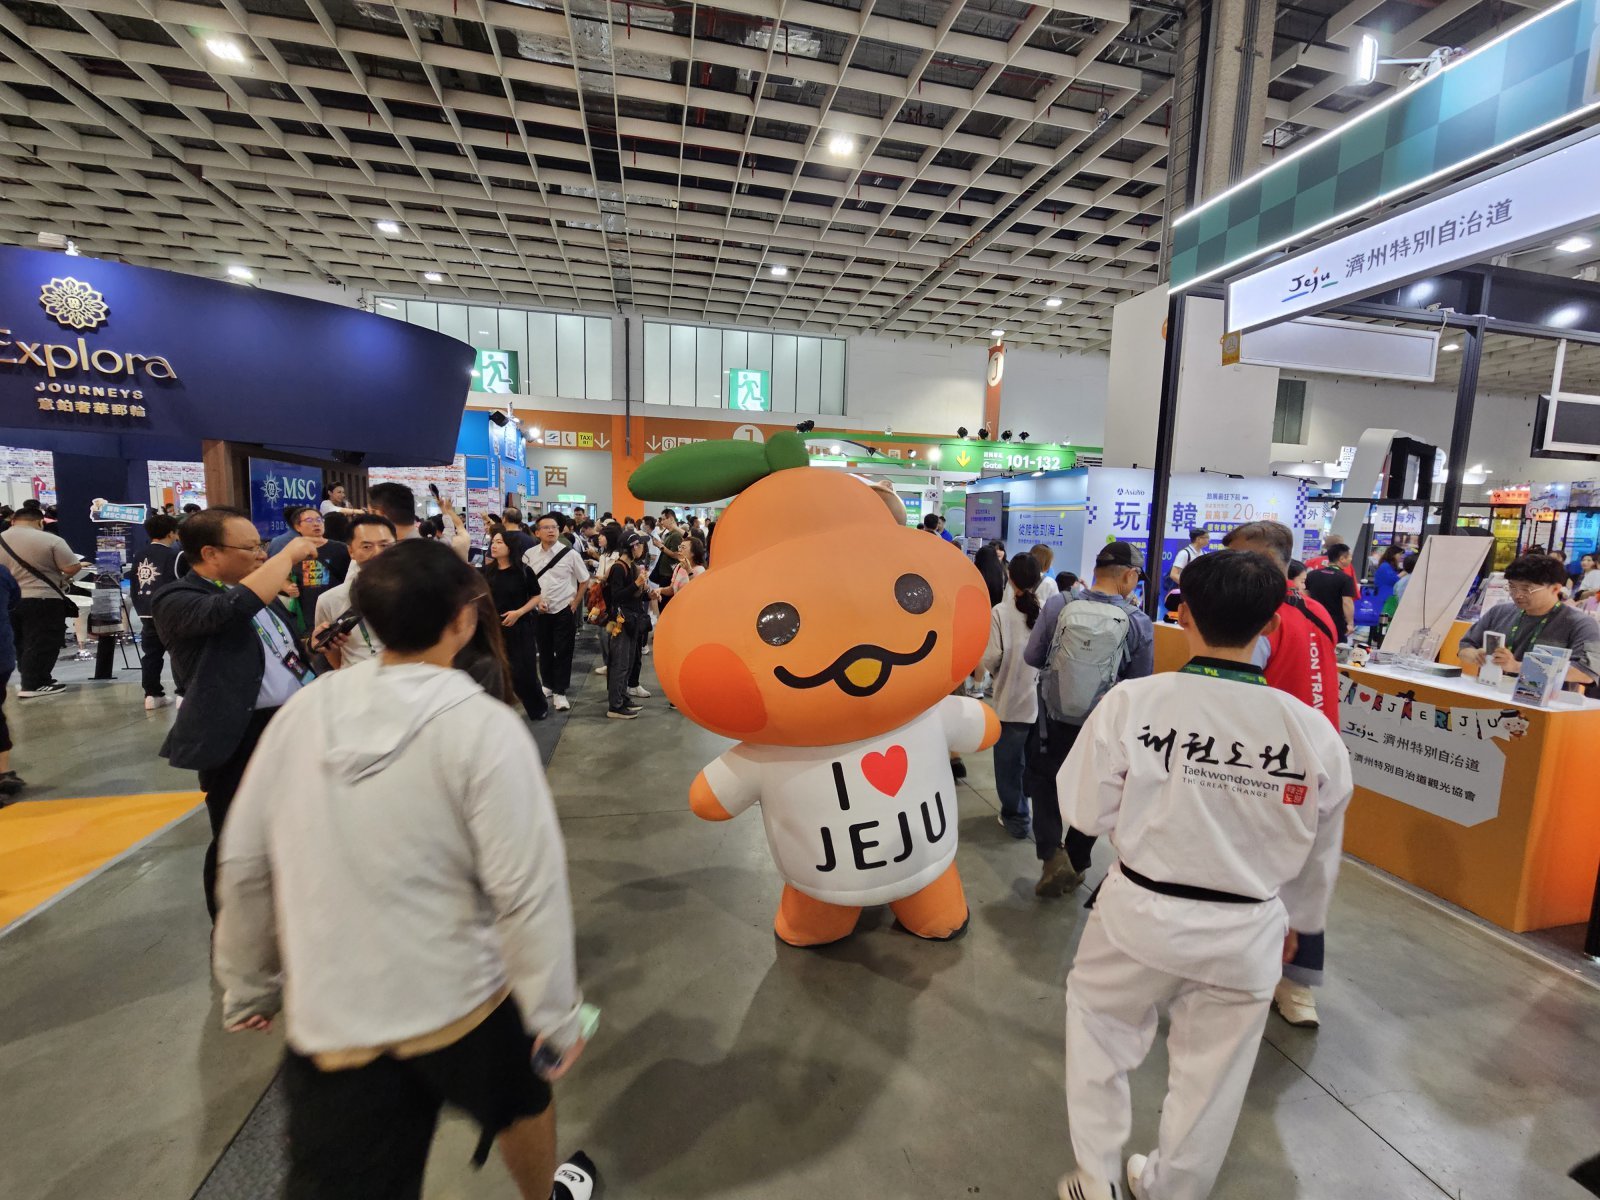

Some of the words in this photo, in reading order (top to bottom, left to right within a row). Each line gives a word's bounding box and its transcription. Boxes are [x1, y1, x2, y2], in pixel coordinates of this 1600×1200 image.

[1346, 199, 1513, 279] 濟州特別自治道
[1288, 267, 1331, 293] Jeju
[34, 382, 144, 400] JOURNEYS
[983, 461, 1003, 469] Gate
[1006, 454, 1060, 470] 101-132
[282, 476, 316, 501] MSC
[544, 465, 568, 487] 西
[1113, 501, 1197, 532] 玩韓
[1346, 721, 1374, 739] Jeju
[1383, 732, 1480, 773] 濟州特別自治道
[832, 761, 850, 811] I
[1182, 764, 1280, 793] Taekwondowon
[1199, 780, 1229, 791] GREAT
[1231, 786, 1269, 799] CHANGE
[1353, 752, 1477, 803] 濟州特別自治道觀光協會
[815, 791, 946, 872] JEJU
